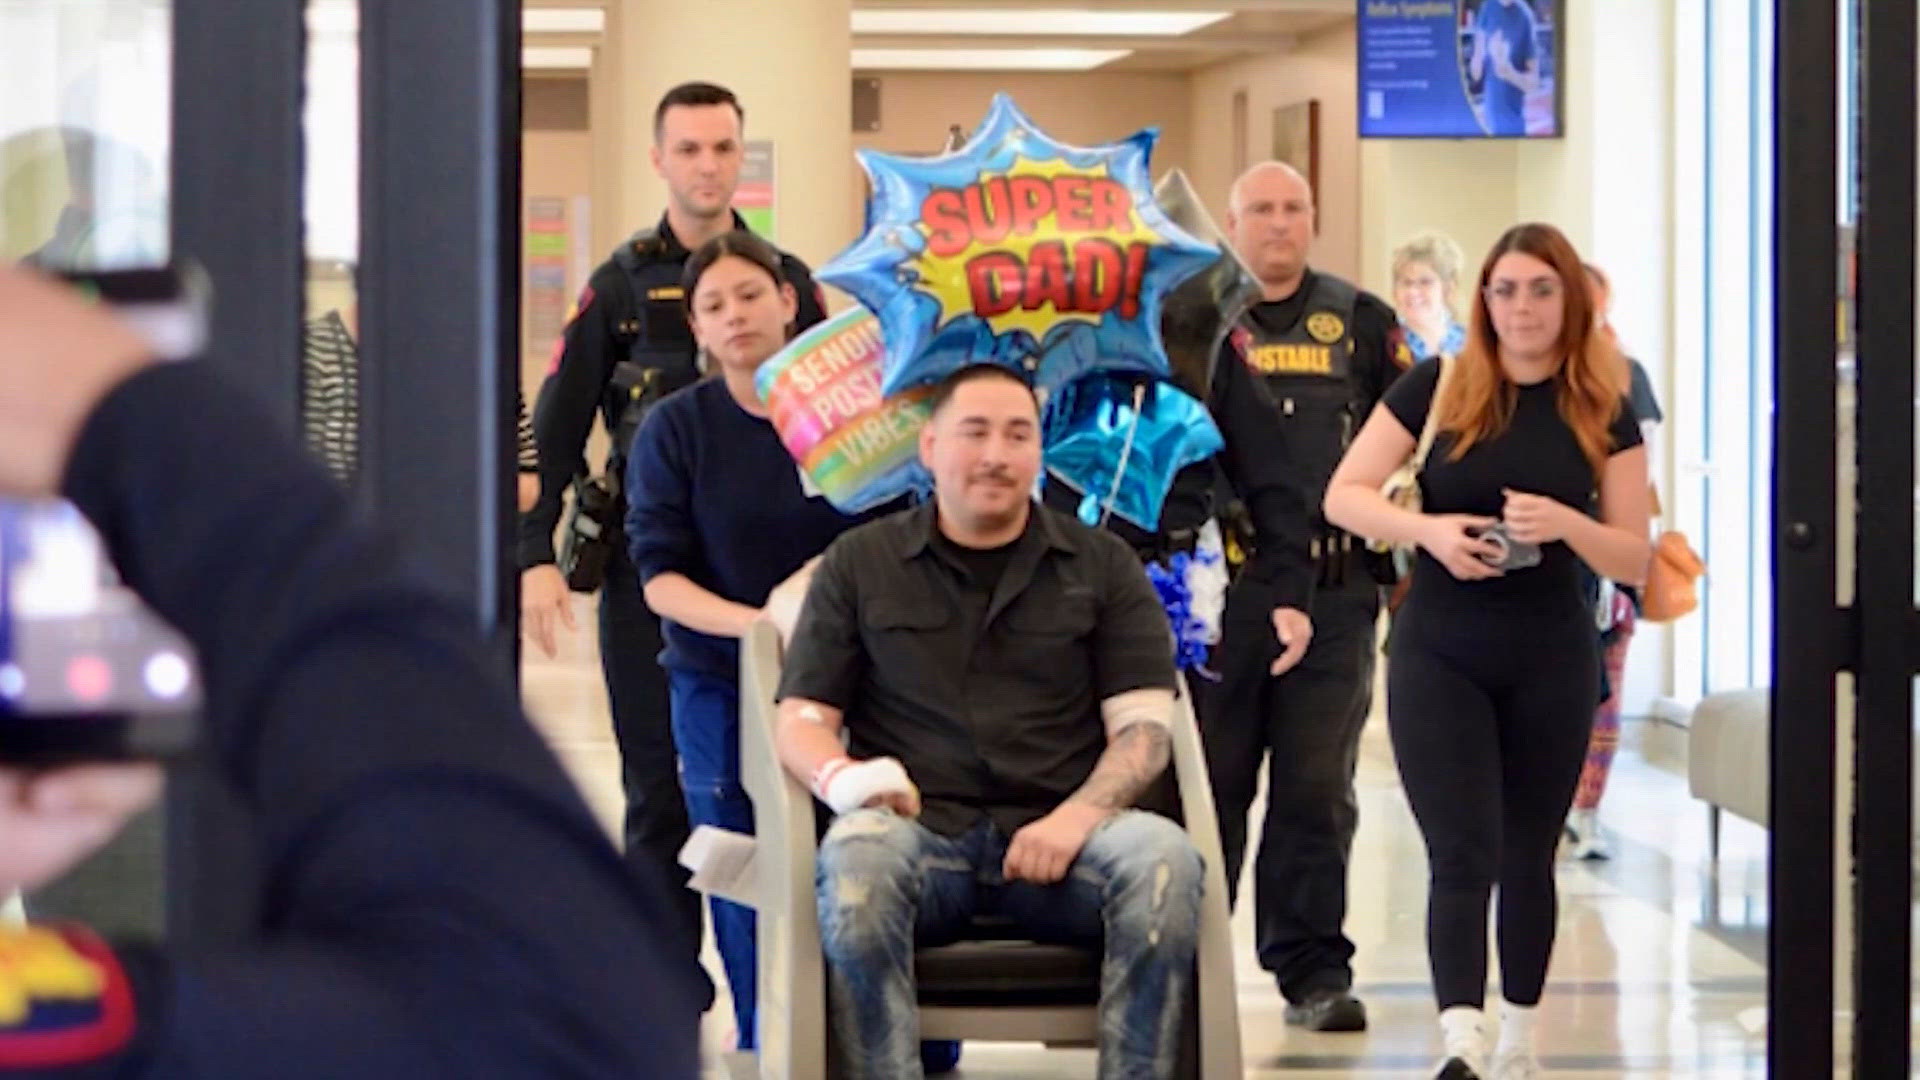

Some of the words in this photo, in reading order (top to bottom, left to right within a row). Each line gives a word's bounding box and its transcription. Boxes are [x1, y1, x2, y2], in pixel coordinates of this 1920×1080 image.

[921, 173, 1134, 258] SUPER
[965, 236, 1149, 320] DAD!
[813, 362, 882, 432] POSI
